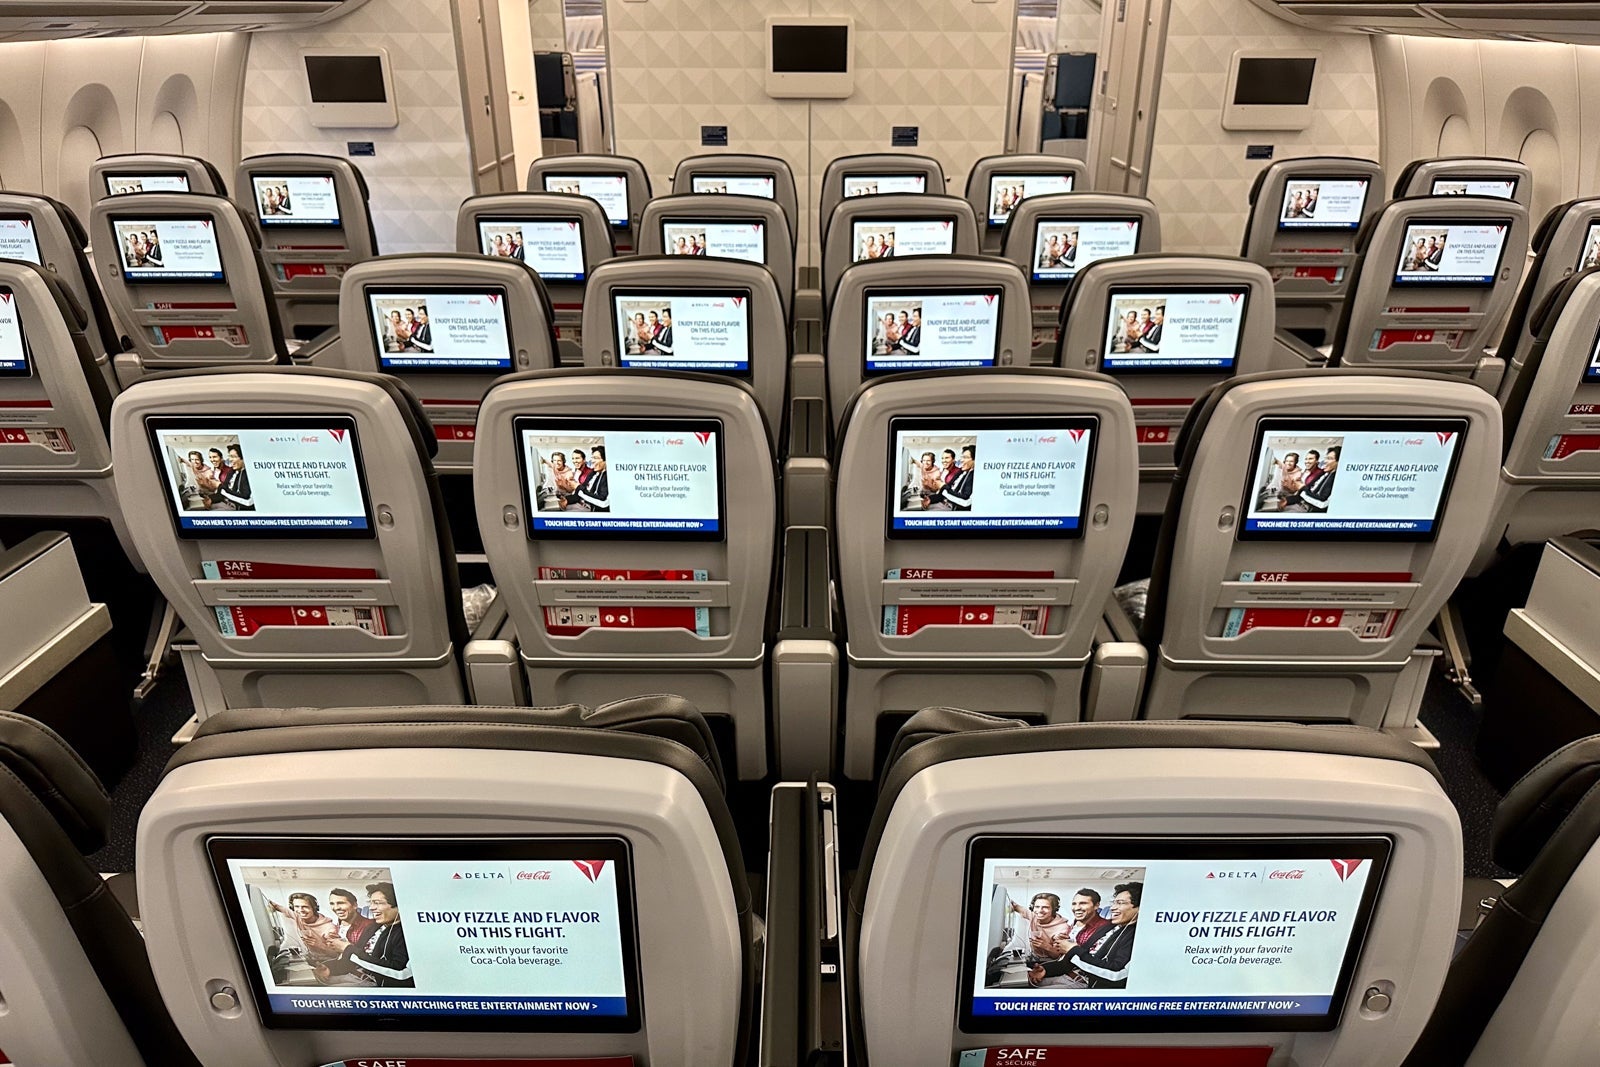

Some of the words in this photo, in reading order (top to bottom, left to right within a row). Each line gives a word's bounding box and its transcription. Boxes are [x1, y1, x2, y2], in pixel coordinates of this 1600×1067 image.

[224, 562, 252, 572] SAFE
[906, 570, 933, 578] SAFE
[1261, 574, 1289, 582] SAFE
[417, 912, 462, 923] ENJOY
[464, 912, 510, 923] FIZZLE
[512, 912, 544, 923] AND
[546, 912, 600, 923] FLAVOR
[1155, 911, 1200, 923] ENJOY
[1202, 911, 1248, 922] FIZZLE
[1249, 911, 1282, 922] AND
[1282, 911, 1338, 922] FLAVOR
[456, 927, 478, 938] ON
[480, 927, 512, 938] THIS
[515, 927, 566, 938] FLIGHT.
[1188, 926, 1210, 938] ON
[1211, 926, 1245, 938] THIS
[1246, 926, 1298, 938] FLIGHT.
[459, 946, 485, 954] Relax
[486, 946, 508, 954] with
[509, 948, 531, 957] your
[532, 946, 569, 954] favorite
[1184, 946, 1210, 954] Relax
[1211, 945, 1233, 954] with
[1233, 948, 1256, 956] your
[1256, 945, 1294, 954] favorite
[470, 956, 516, 965] Coca-Cola
[518, 957, 563, 967] beverage.
[1191, 956, 1238, 965] Coca-Cola
[1238, 956, 1284, 966] beverage.
[291, 1000, 326, 1008] TOUCH
[353, 1000, 368, 1008] TO
[369, 1001, 400, 1009] START
[400, 1001, 455, 1010] WATCHING
[455, 1002, 480, 1010] FREE
[480, 1002, 564, 1010] ENTERTAINMENT
[565, 1002, 591, 1011] NOW
[994, 1002, 1028, 1011] TOUCH
[1030, 1002, 1056, 1010] HERE
[1057, 1002, 1071, 1011] TO
[1072, 1002, 1103, 1011] START
[1104, 1002, 1158, 1011] WATCHING
[1158, 1002, 1184, 1010] FREE
[1183, 1002, 1267, 1011] ENTERTAINMENT
[1267, 1001, 1294, 1010] NOW
[997, 1049, 1047, 1060] SAFE
